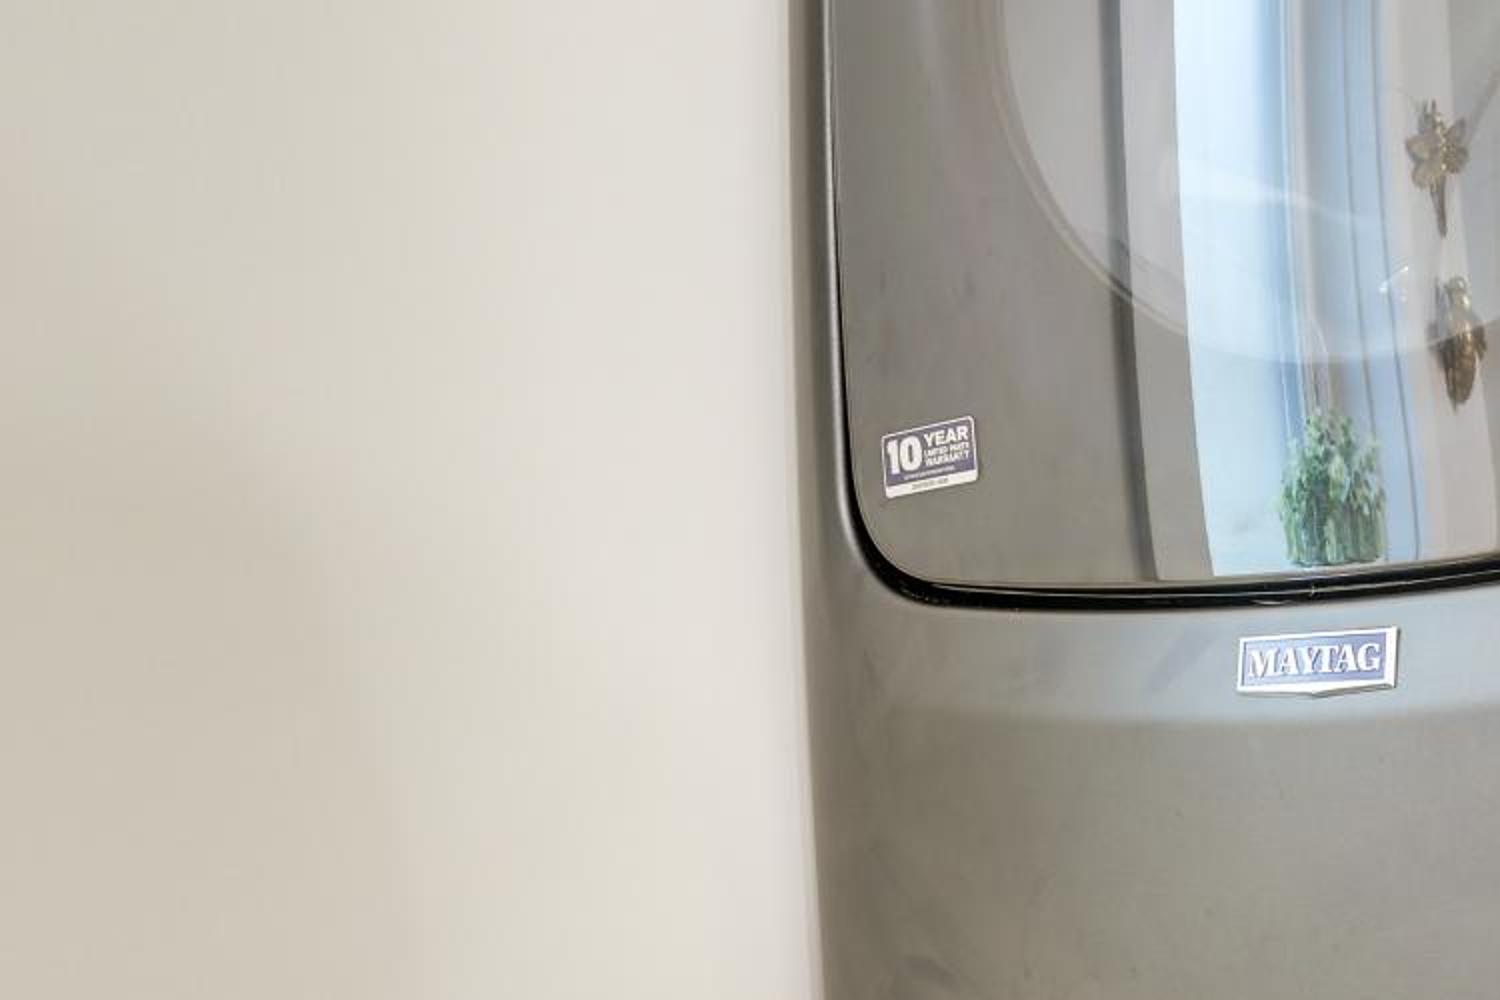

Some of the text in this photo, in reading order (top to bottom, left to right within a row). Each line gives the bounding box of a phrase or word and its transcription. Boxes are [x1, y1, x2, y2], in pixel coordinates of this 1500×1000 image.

[887, 436, 922, 475] 10
[923, 425, 969, 447] YEAR
[1249, 643, 1381, 678] MAYTAG
